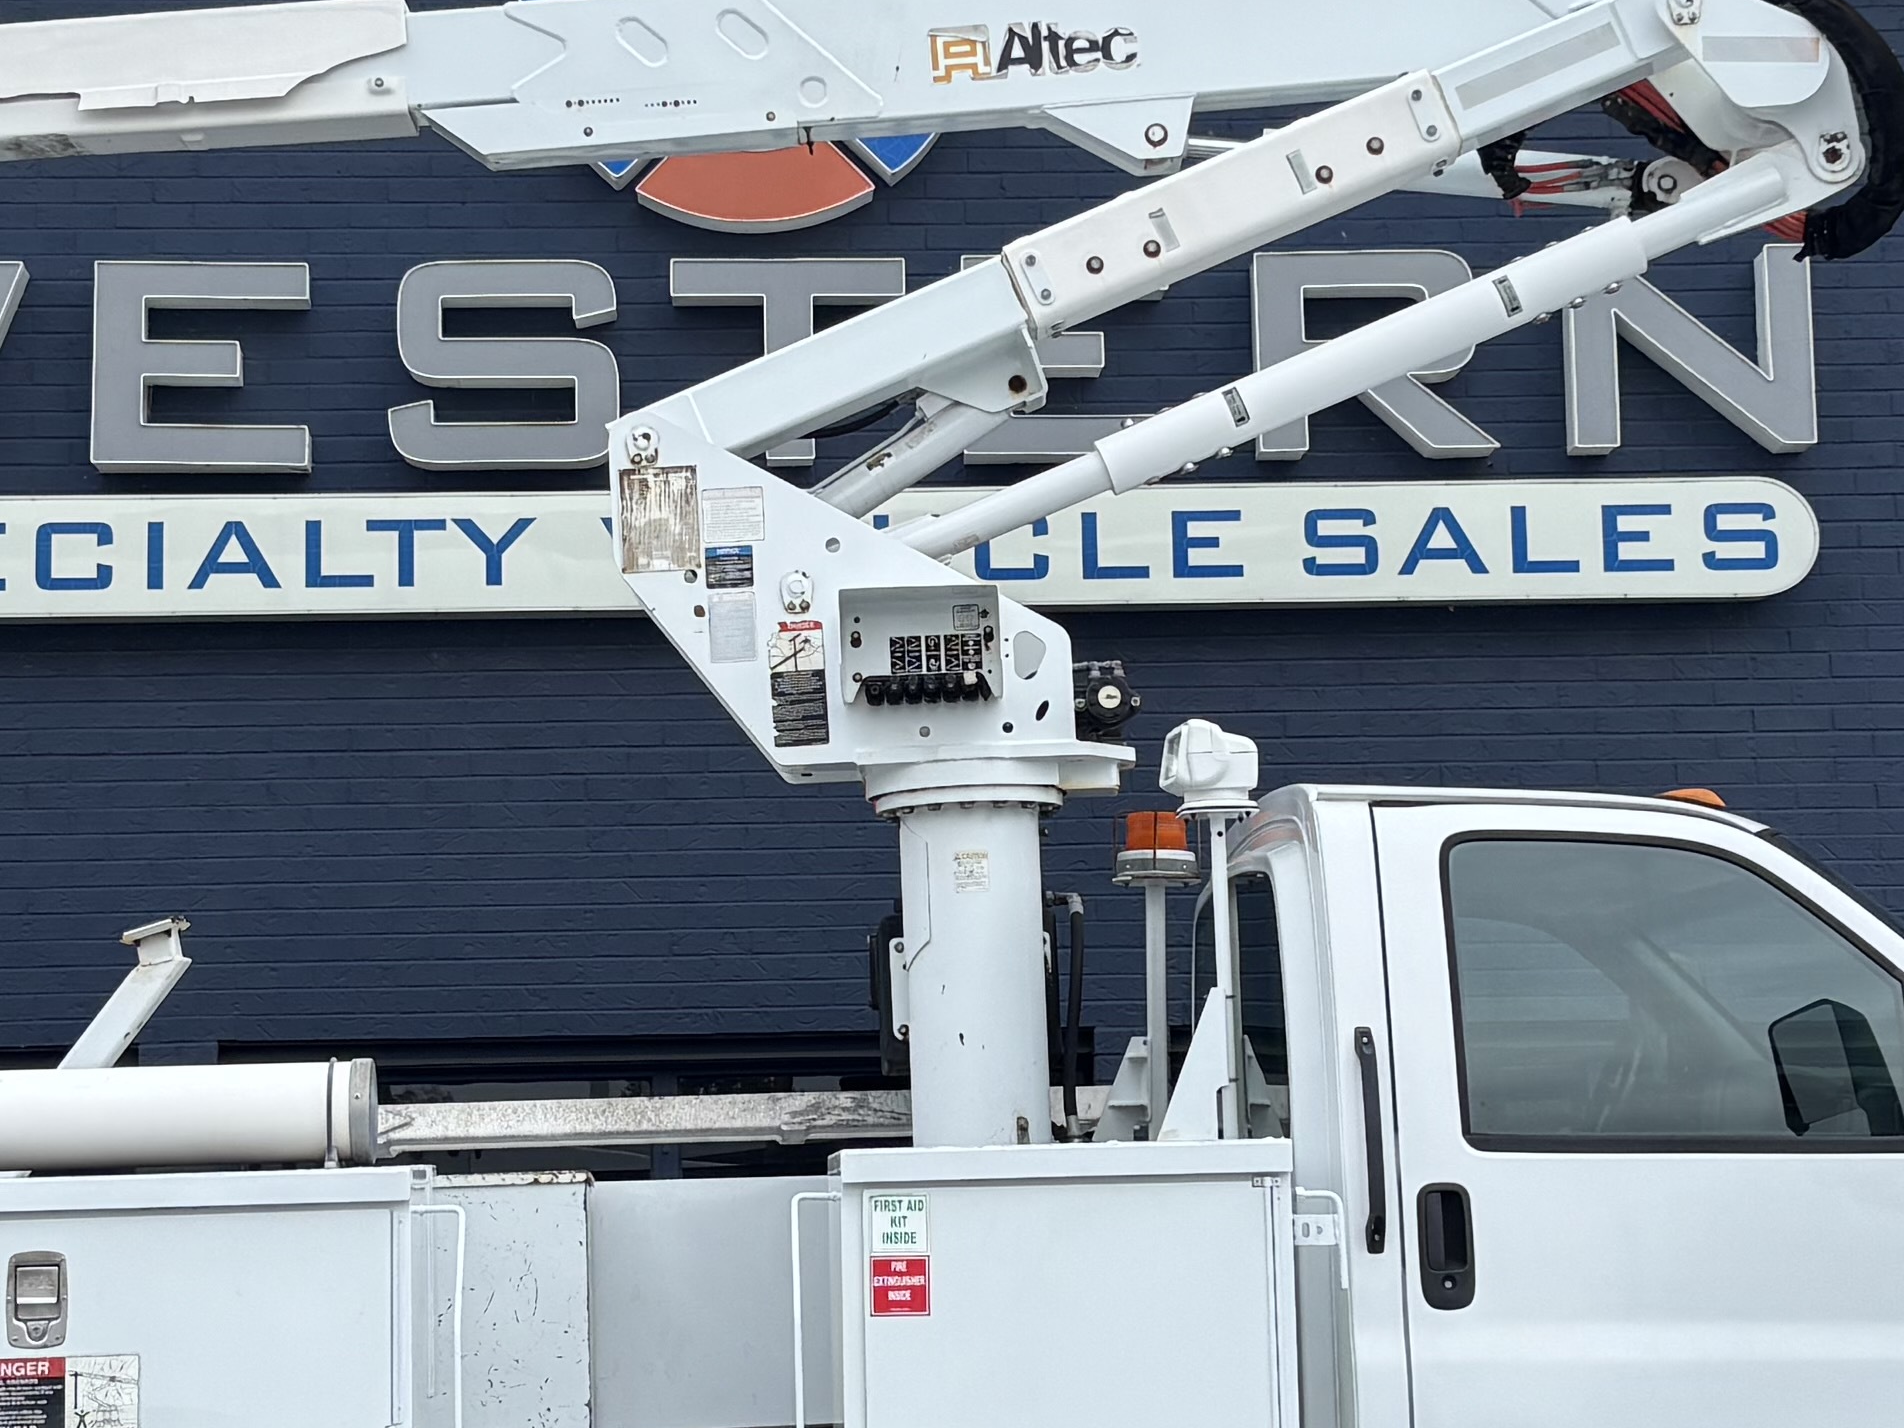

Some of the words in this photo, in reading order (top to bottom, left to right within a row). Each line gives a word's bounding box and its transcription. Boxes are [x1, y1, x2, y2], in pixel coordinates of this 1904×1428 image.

[996, 21, 1139, 76] Altec
[1301, 501, 1781, 578] SALES
[874, 1199, 903, 1212] FIRST
[907, 1199, 924, 1212] AID
[890, 1215, 908, 1228] KIT
[882, 1232, 917, 1245] INSIDE
